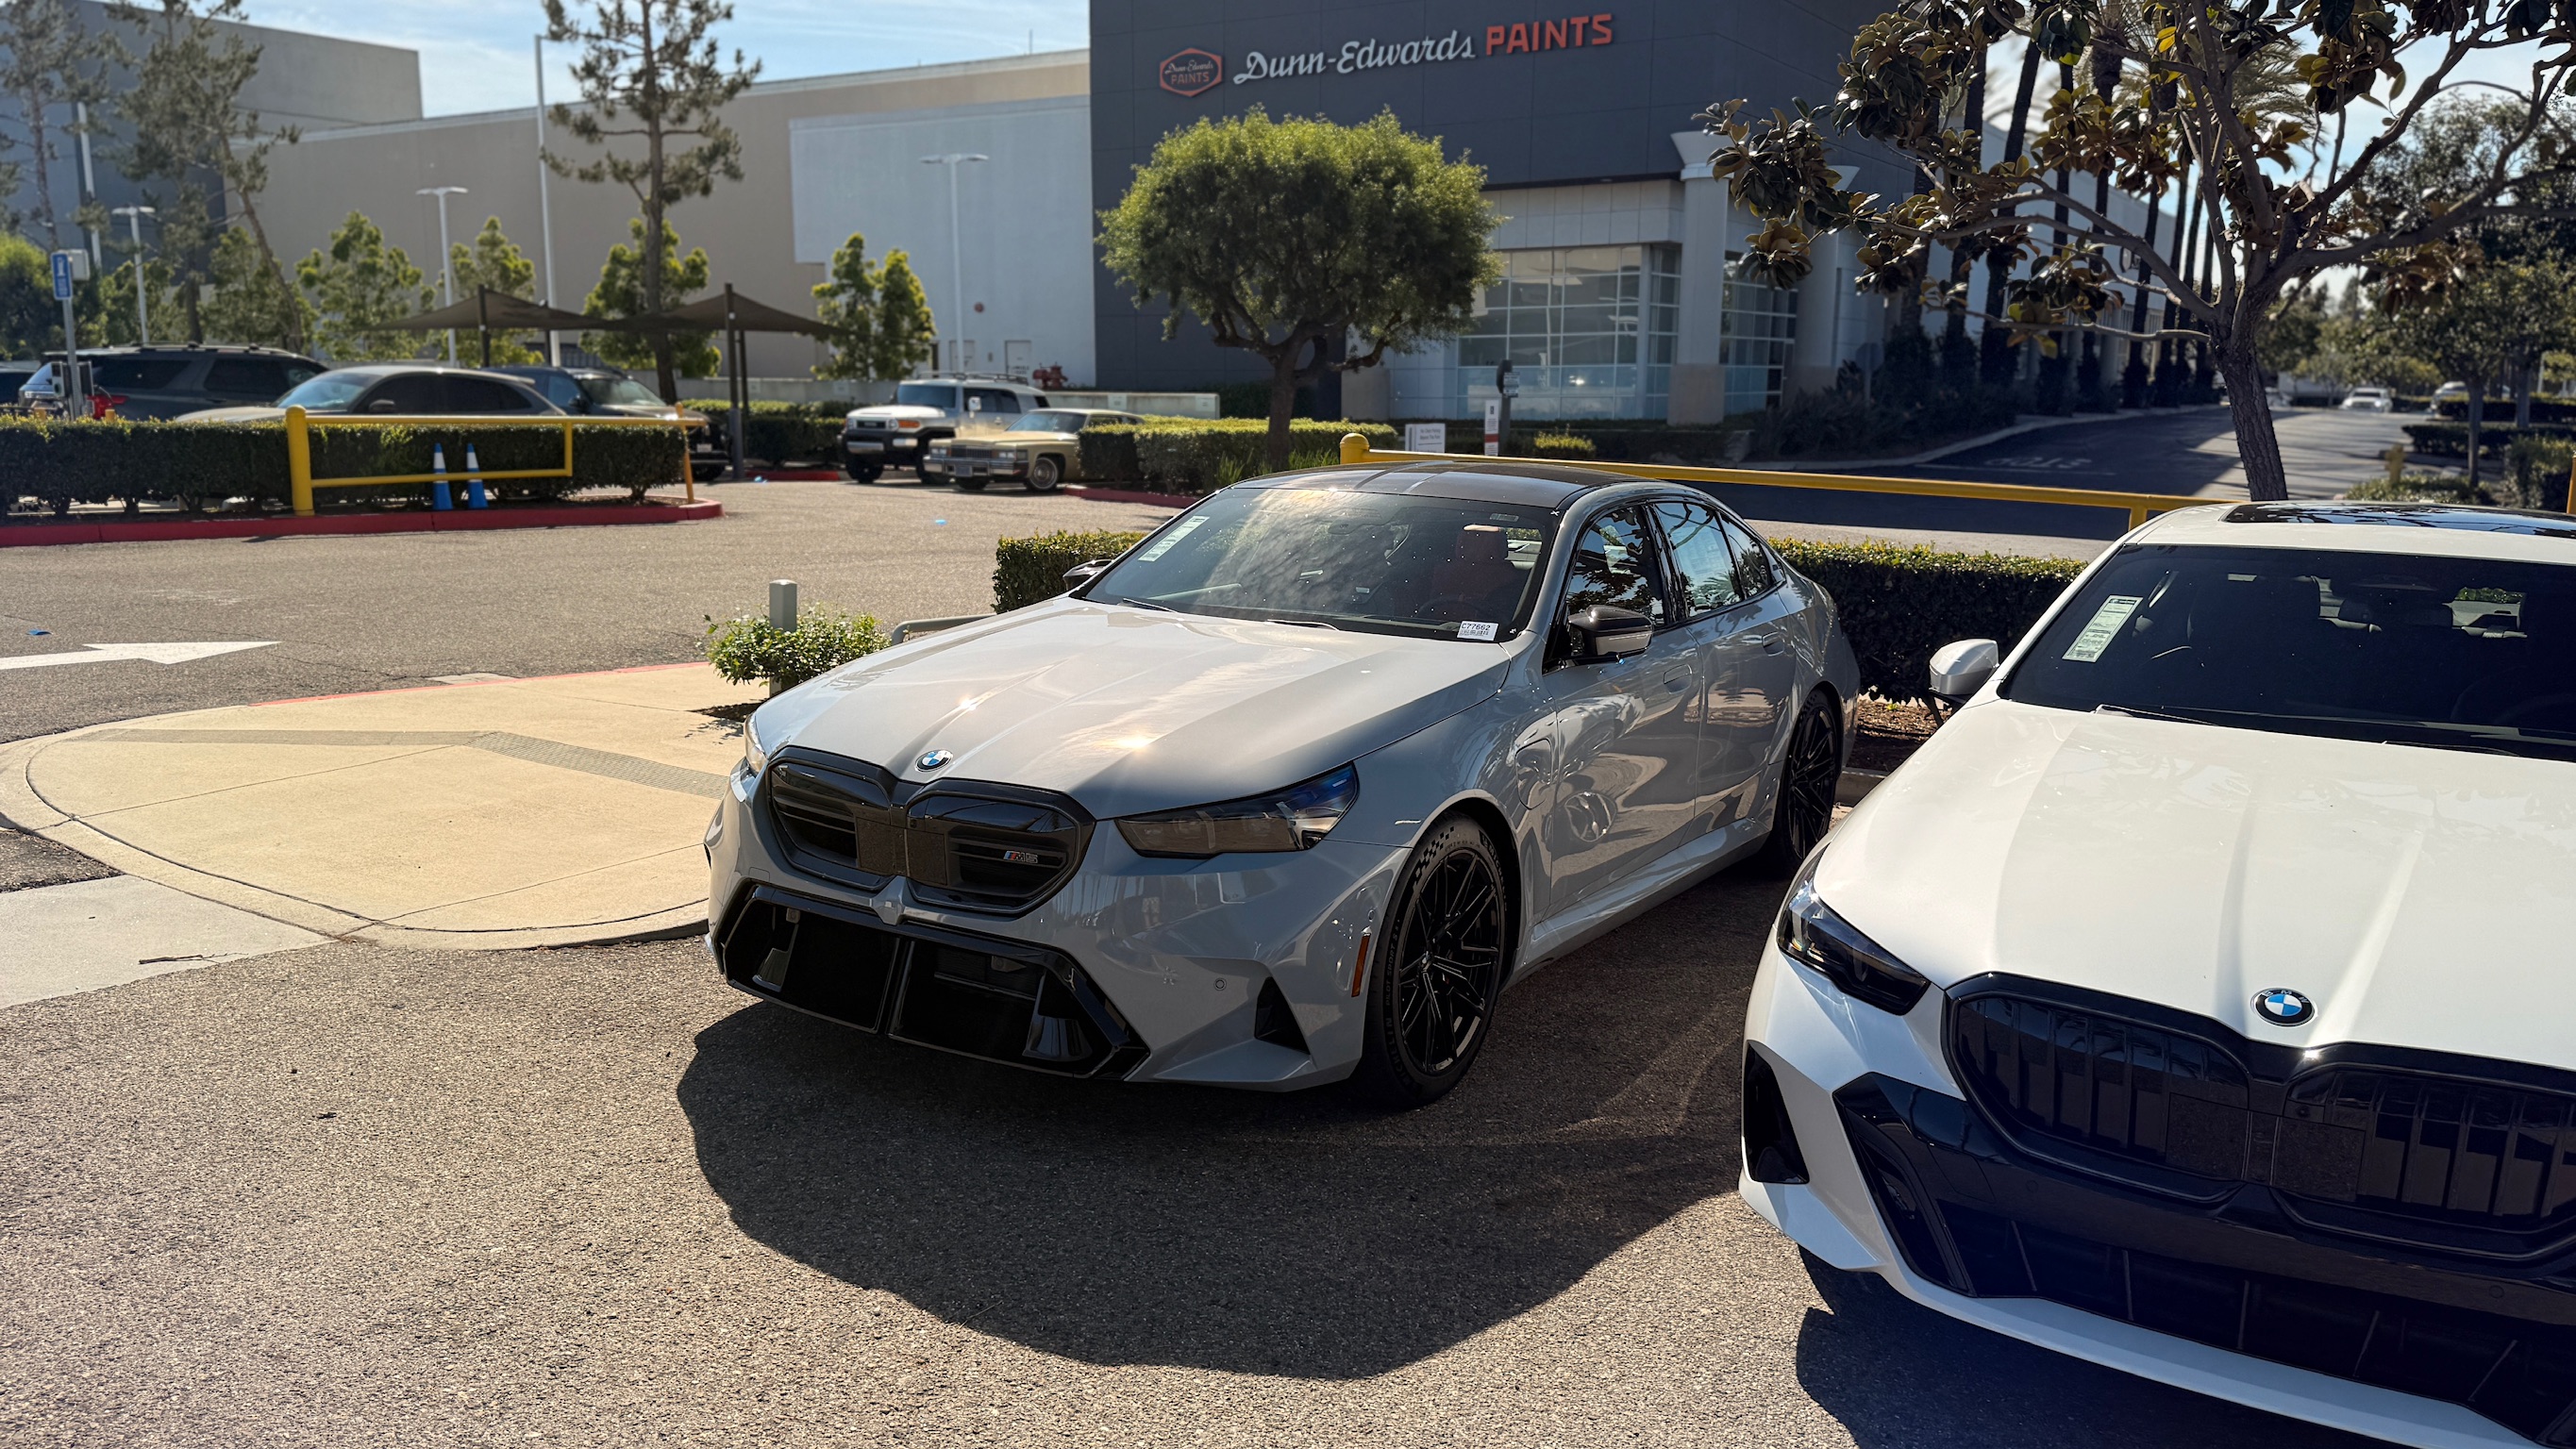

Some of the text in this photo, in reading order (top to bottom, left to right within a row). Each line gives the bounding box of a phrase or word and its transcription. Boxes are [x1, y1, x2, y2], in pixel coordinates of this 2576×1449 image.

[1233, 13, 1613, 85] Dunn-Edwards PAINTS
[1171, 72, 1210, 85] PAINTS
